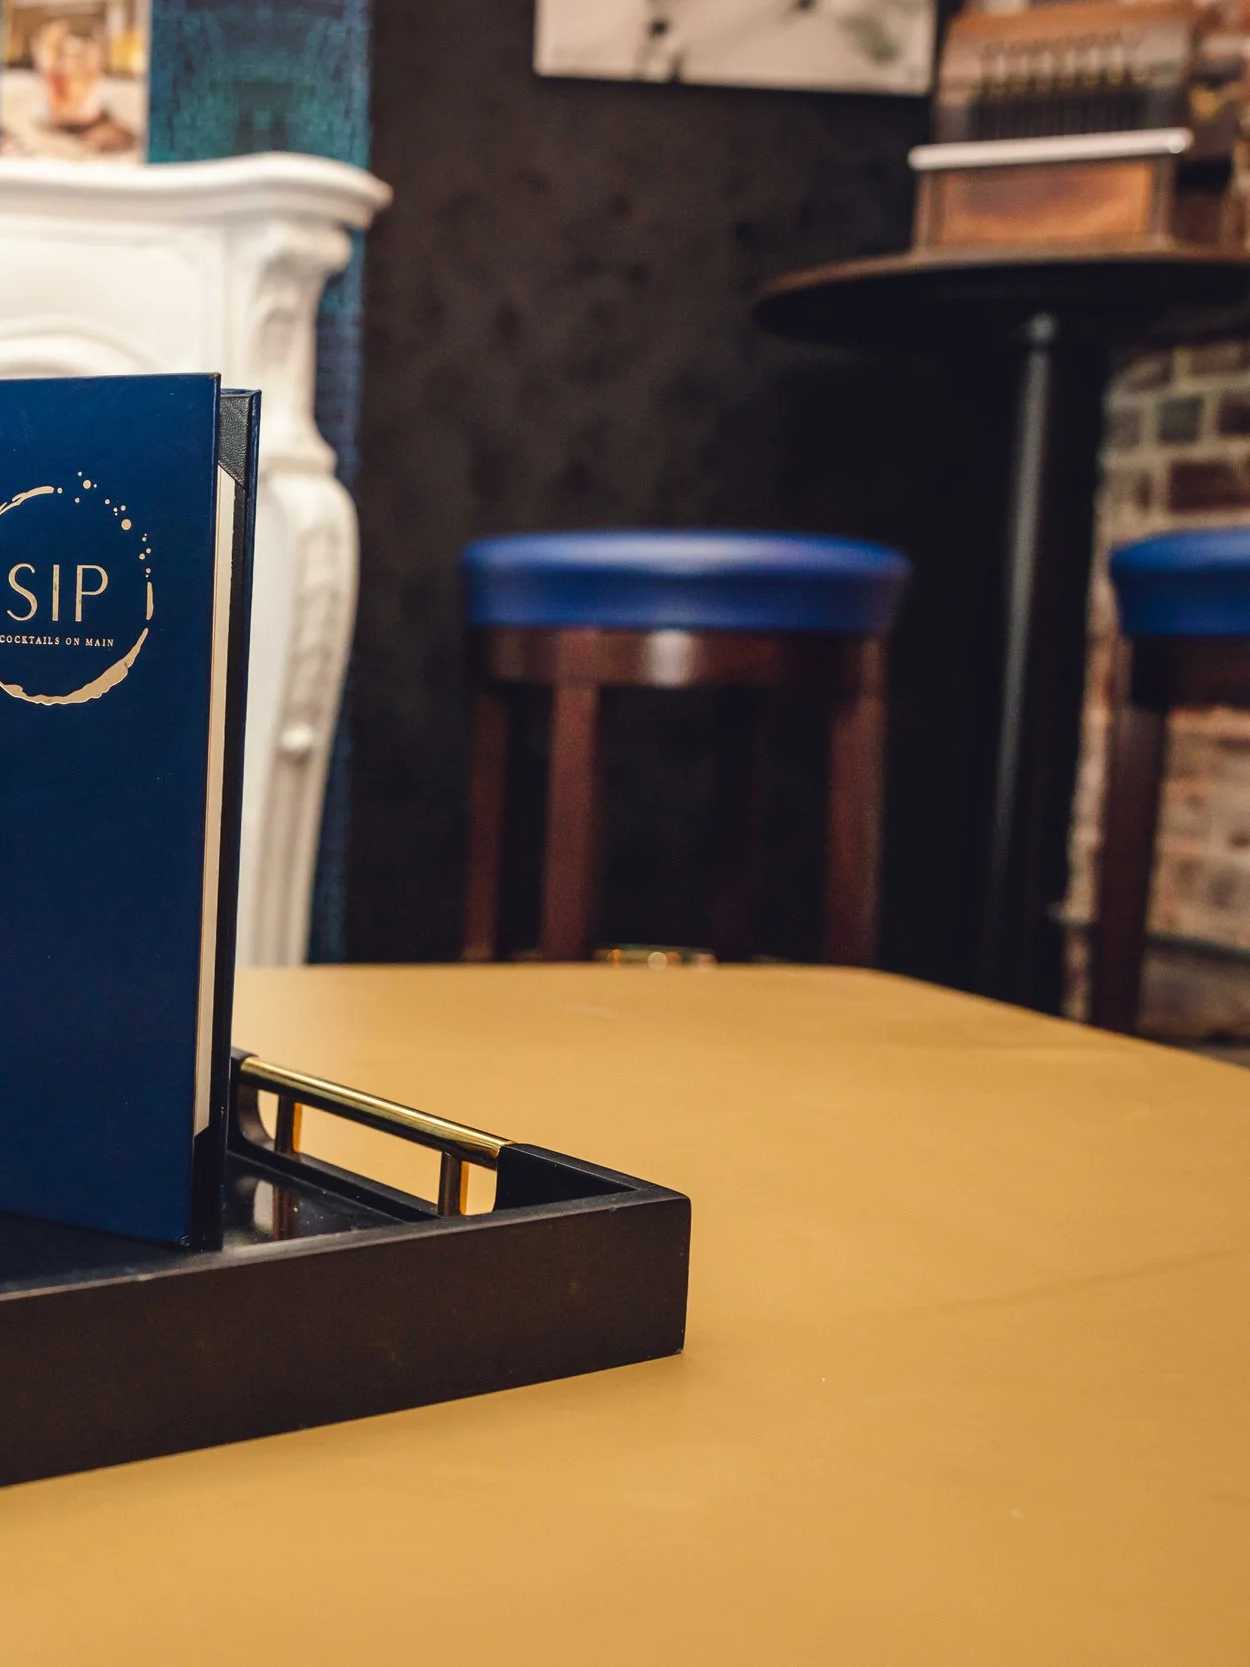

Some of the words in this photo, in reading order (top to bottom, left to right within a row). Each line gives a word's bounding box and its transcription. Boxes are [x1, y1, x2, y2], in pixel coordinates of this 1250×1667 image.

[6, 562, 109, 622] SIP
[65, 637, 80, 646] ON
[85, 638, 114, 647] MAIN
